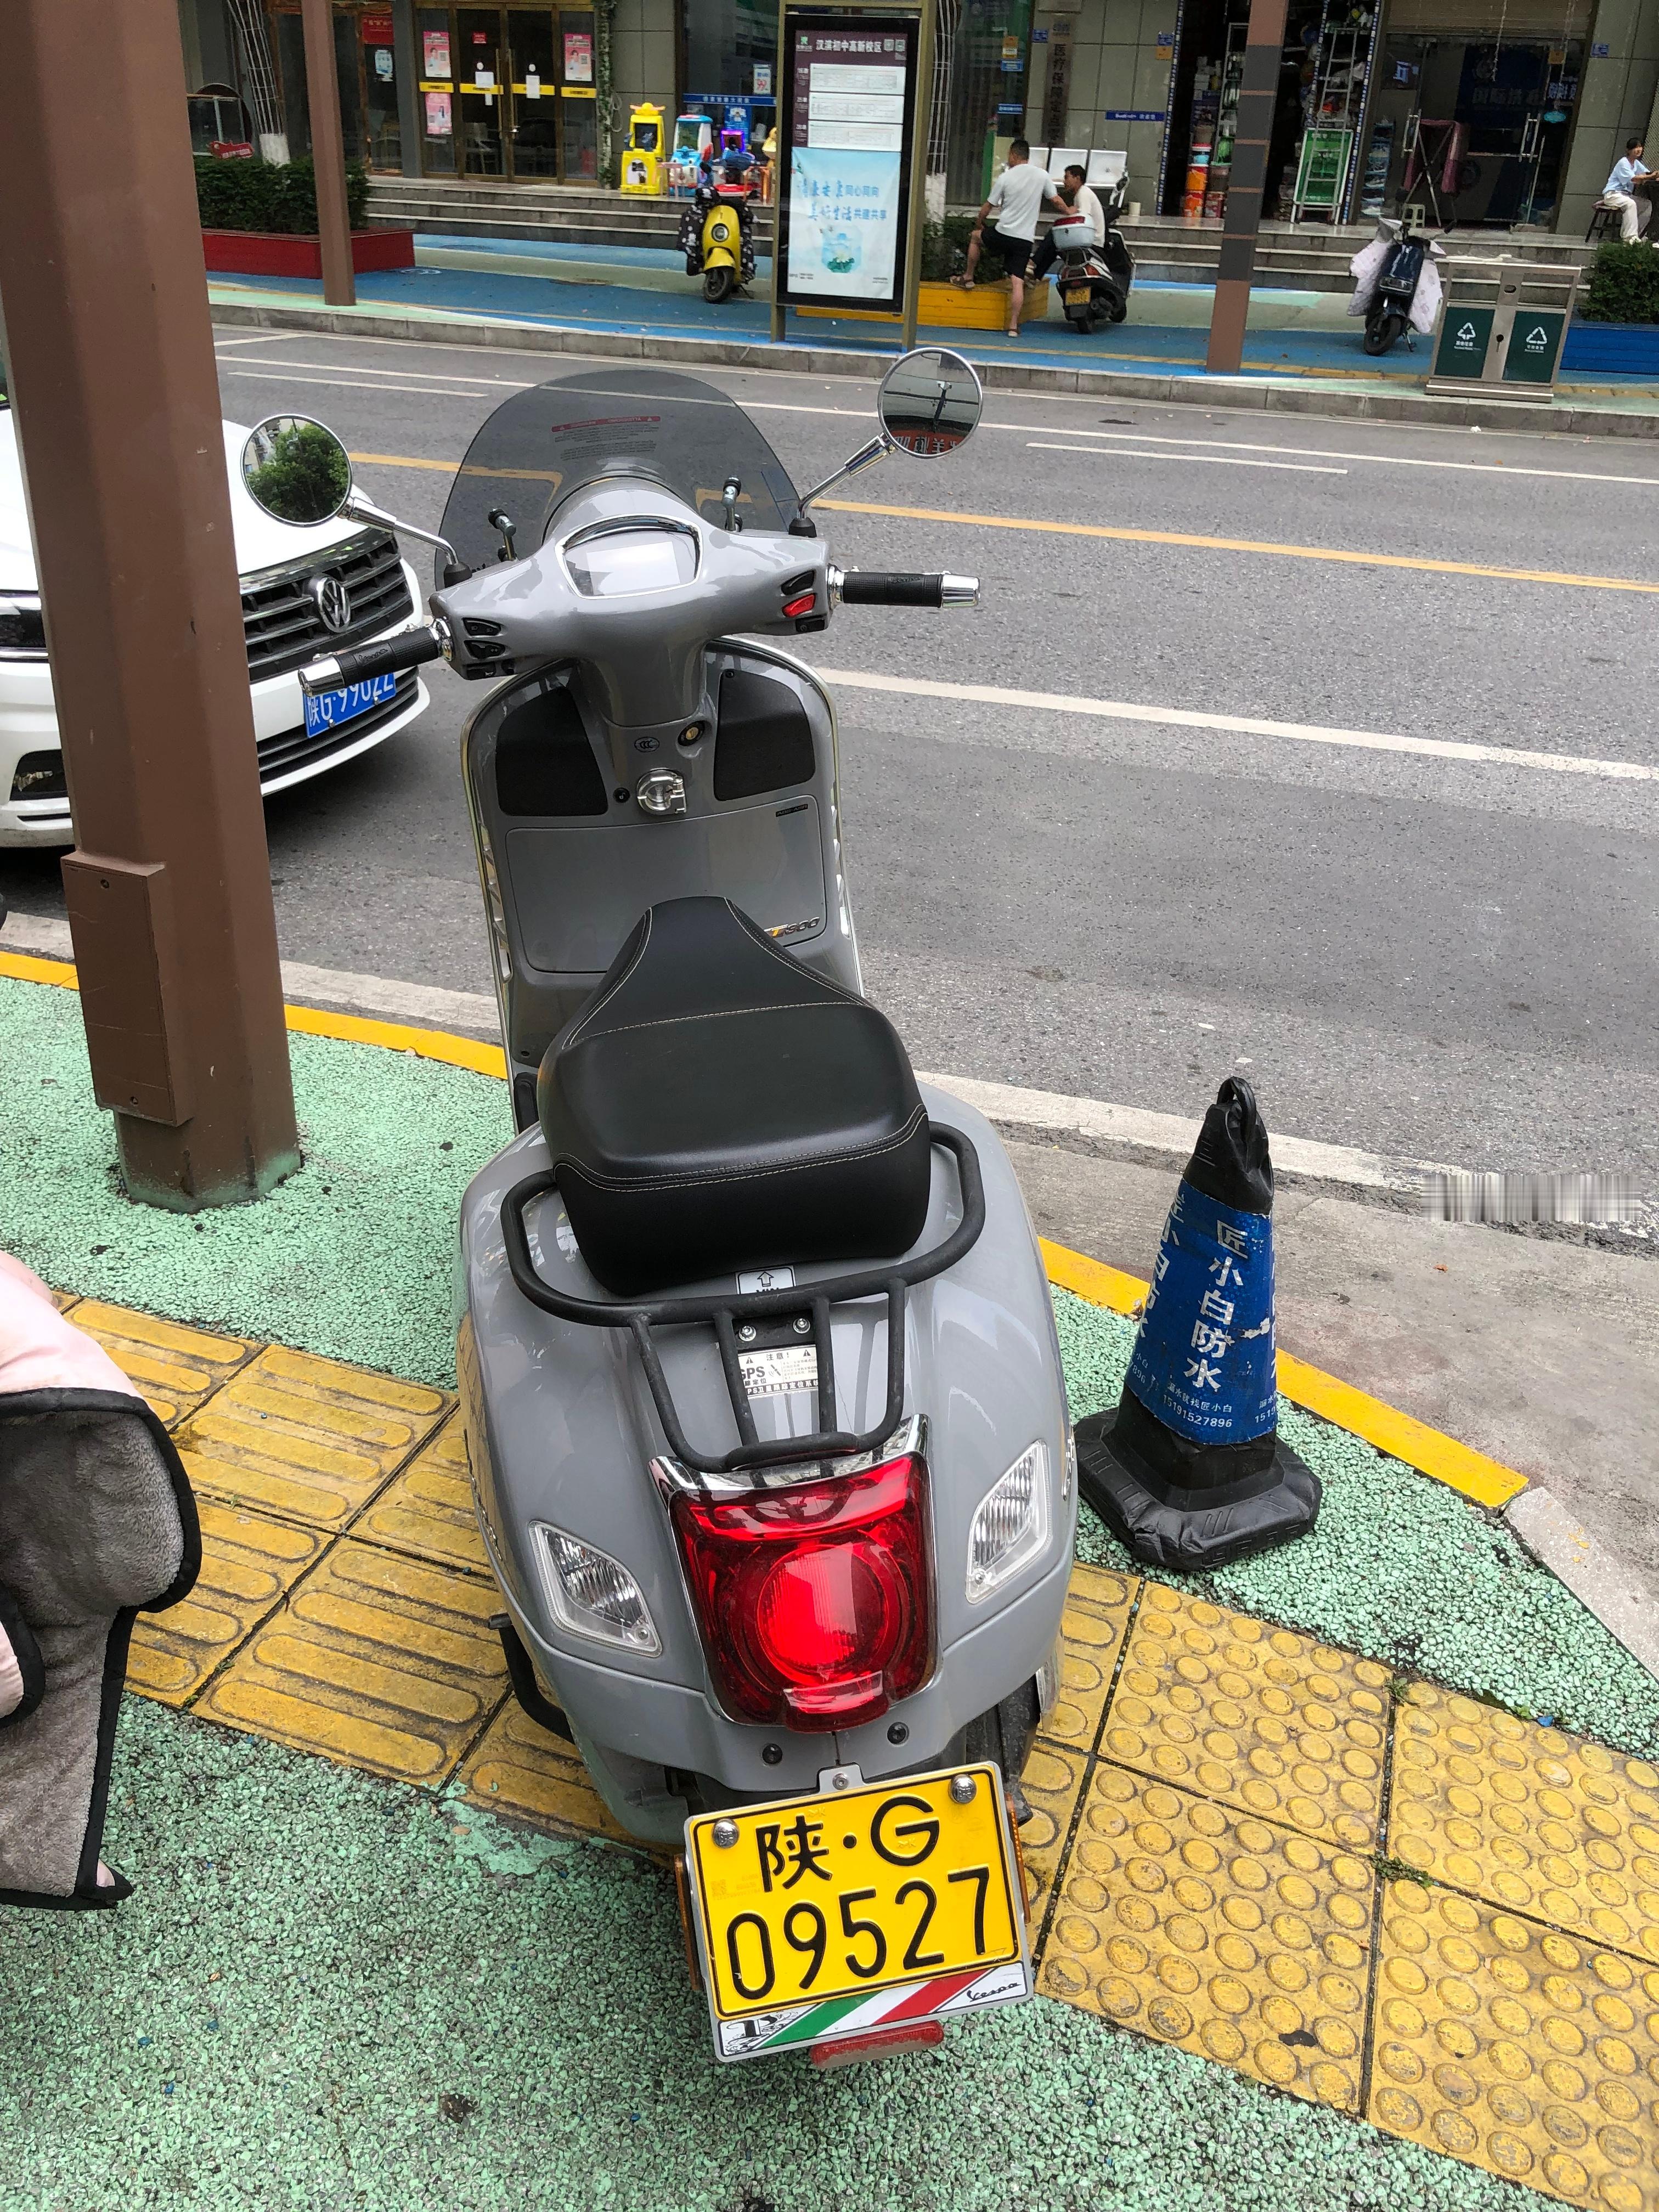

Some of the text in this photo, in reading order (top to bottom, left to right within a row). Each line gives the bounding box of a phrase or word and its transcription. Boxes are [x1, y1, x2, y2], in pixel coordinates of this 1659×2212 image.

[816, 40, 882, 53] 汉滨初中高新校区
[1183, 1220, 1249, 1389] 匠小白防水
[1163, 1394, 1233, 1428] 15191527896
[755, 1795, 940, 1892] 陕·G
[726, 1866, 990, 2000] 09527
[966, 1982, 1022, 2002] Vespa
